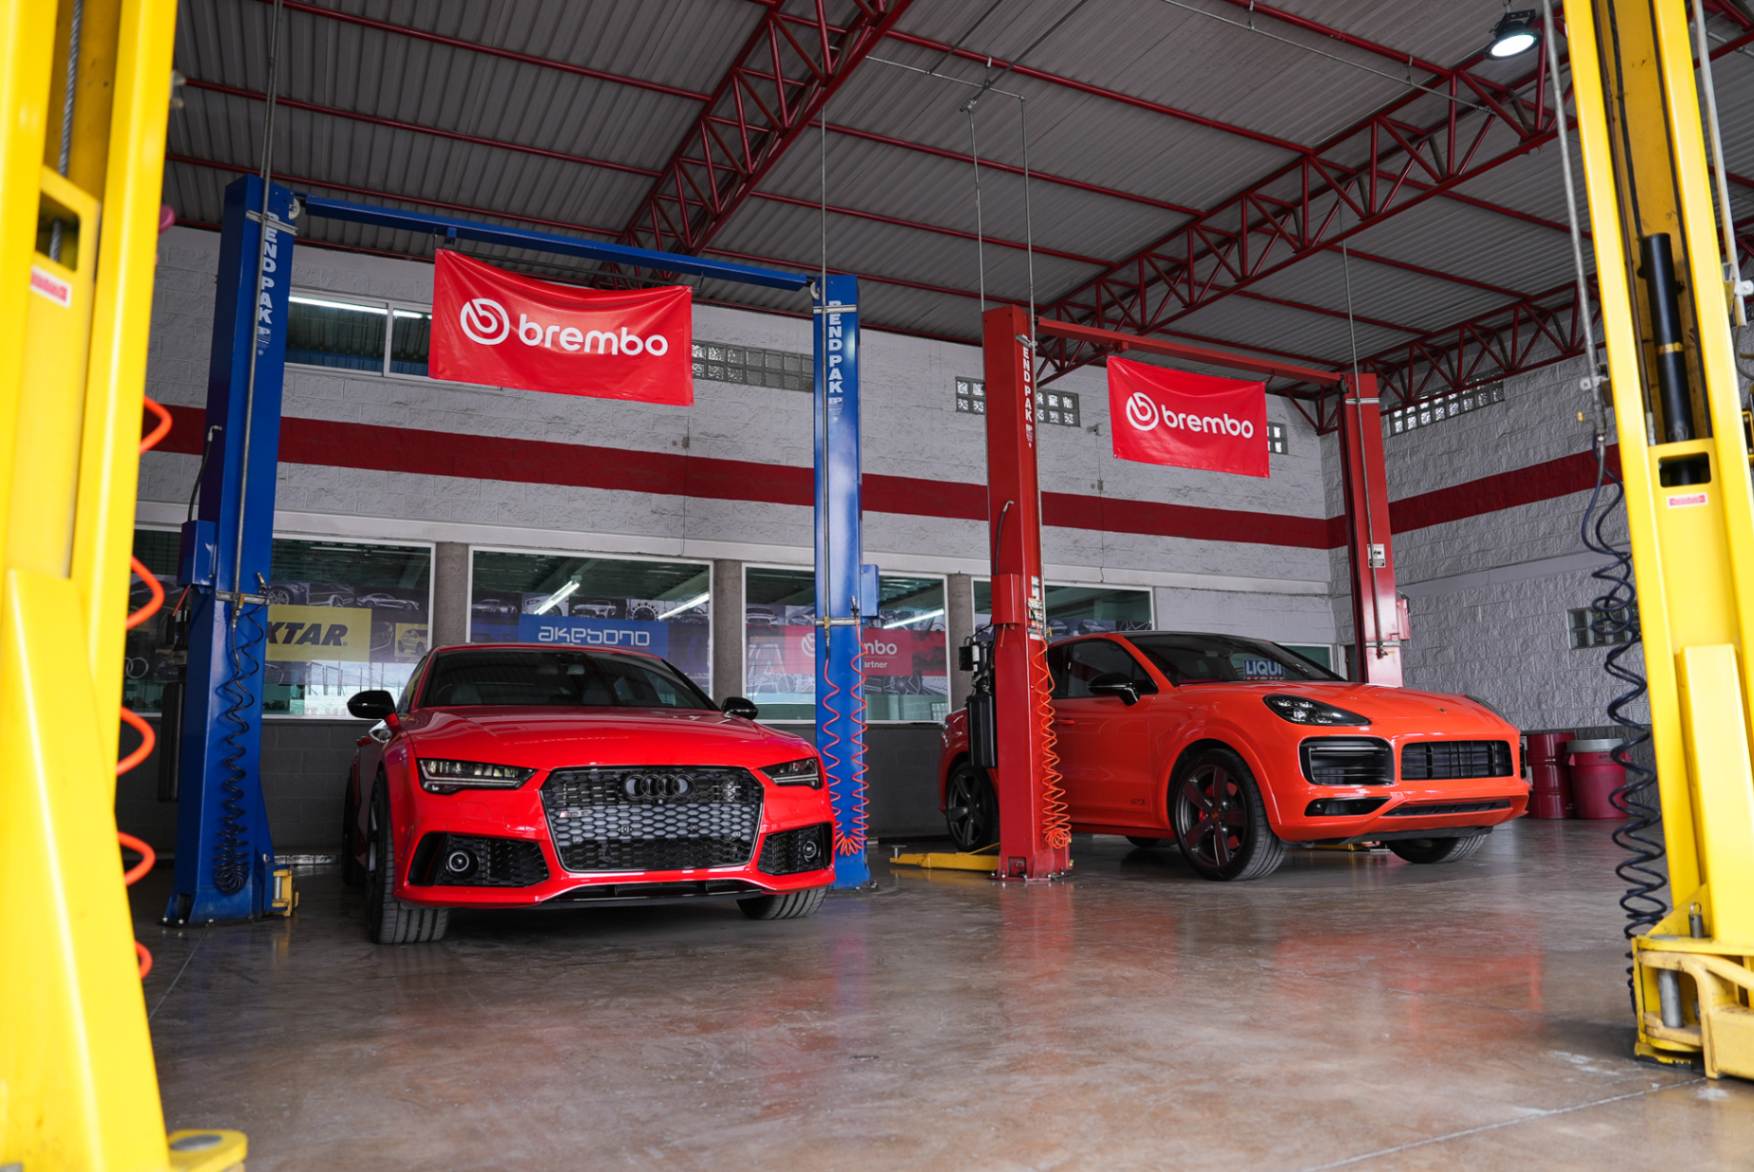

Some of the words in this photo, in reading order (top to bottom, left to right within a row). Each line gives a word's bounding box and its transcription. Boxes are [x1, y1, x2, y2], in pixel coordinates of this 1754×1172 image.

[518, 313, 669, 356] brembo
[1022, 334, 1032, 422] ENDPAK
[1161, 404, 1254, 439] brembo
[538, 626, 650, 646] akebono
[864, 661, 888, 669] artner
[1246, 660, 1282, 676] LIQUI
